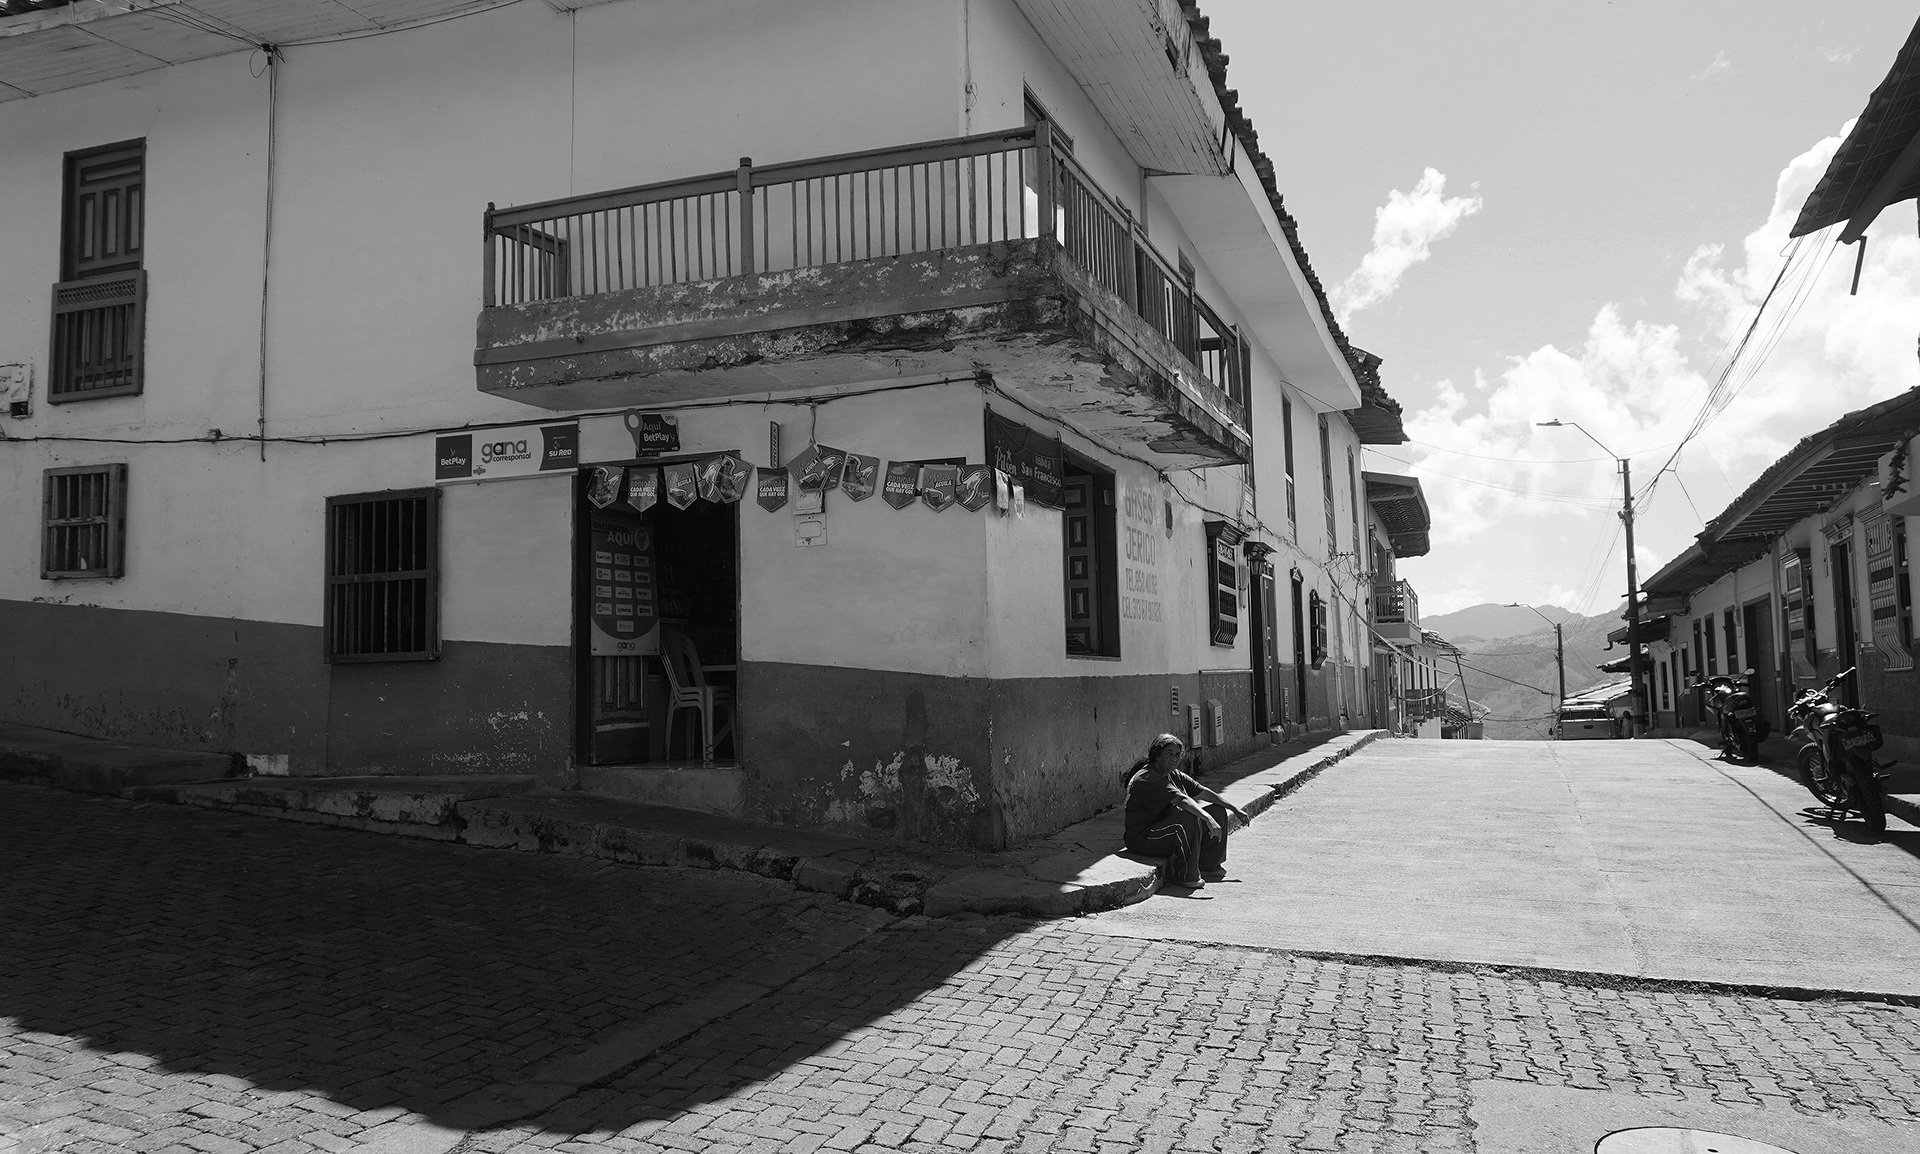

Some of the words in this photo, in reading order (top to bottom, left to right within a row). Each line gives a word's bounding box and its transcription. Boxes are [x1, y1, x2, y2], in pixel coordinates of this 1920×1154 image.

[643, 432, 669, 442] BetPlay
[481, 440, 527, 464] gana
[492, 452, 532, 463] corresponsal
[440, 457, 467, 466] BetPlay
[607, 530, 634, 547] AQUÍ
[1126, 525, 1156, 567] JERICO
[617, 641, 635, 652] gana
